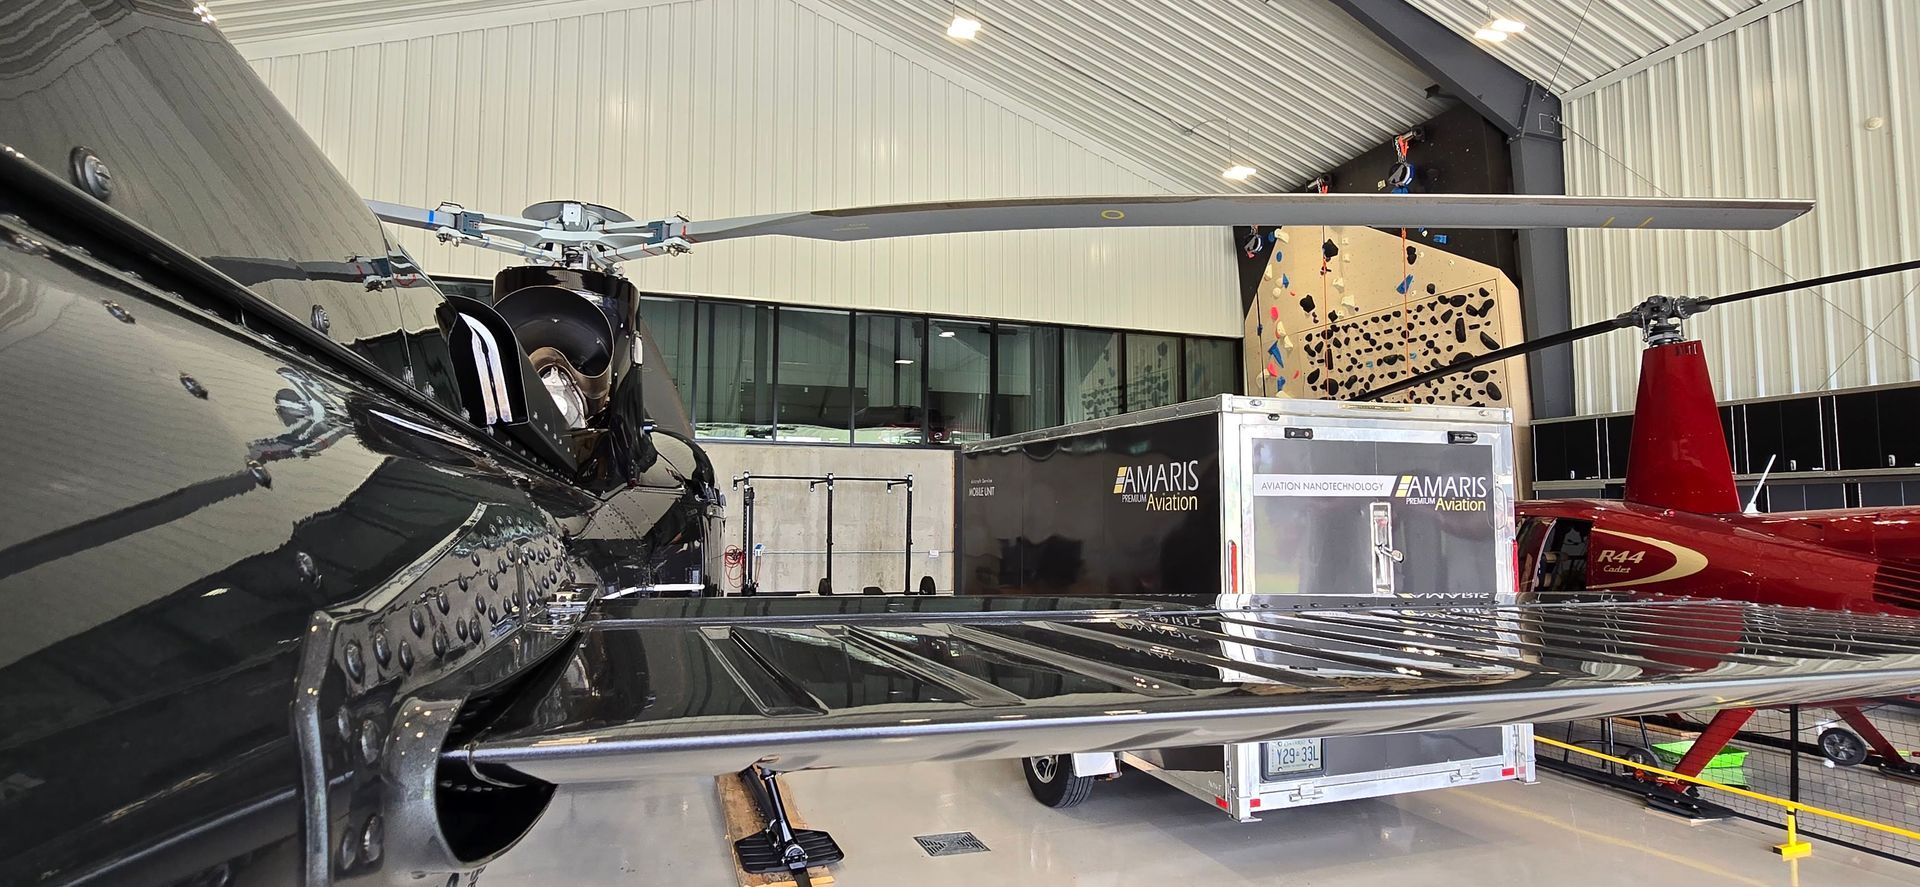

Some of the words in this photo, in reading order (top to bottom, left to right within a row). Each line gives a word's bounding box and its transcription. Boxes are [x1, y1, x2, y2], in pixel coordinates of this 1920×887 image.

[1122, 460, 1199, 493] AMARIS
[1261, 481, 1301, 491] AVIATION
[1303, 482, 1384, 491] NANOTECHNOLOGY
[1406, 475, 1487, 497] AMARIS
[1121, 494, 1147, 503] PREMIUM
[1146, 492, 1199, 511] Aviation
[1405, 497, 1435, 505] PREMIUM
[1435, 497, 1486, 511] Aviation
[1597, 549, 1646, 564] R44
[1603, 564, 1631, 573] Cadet
